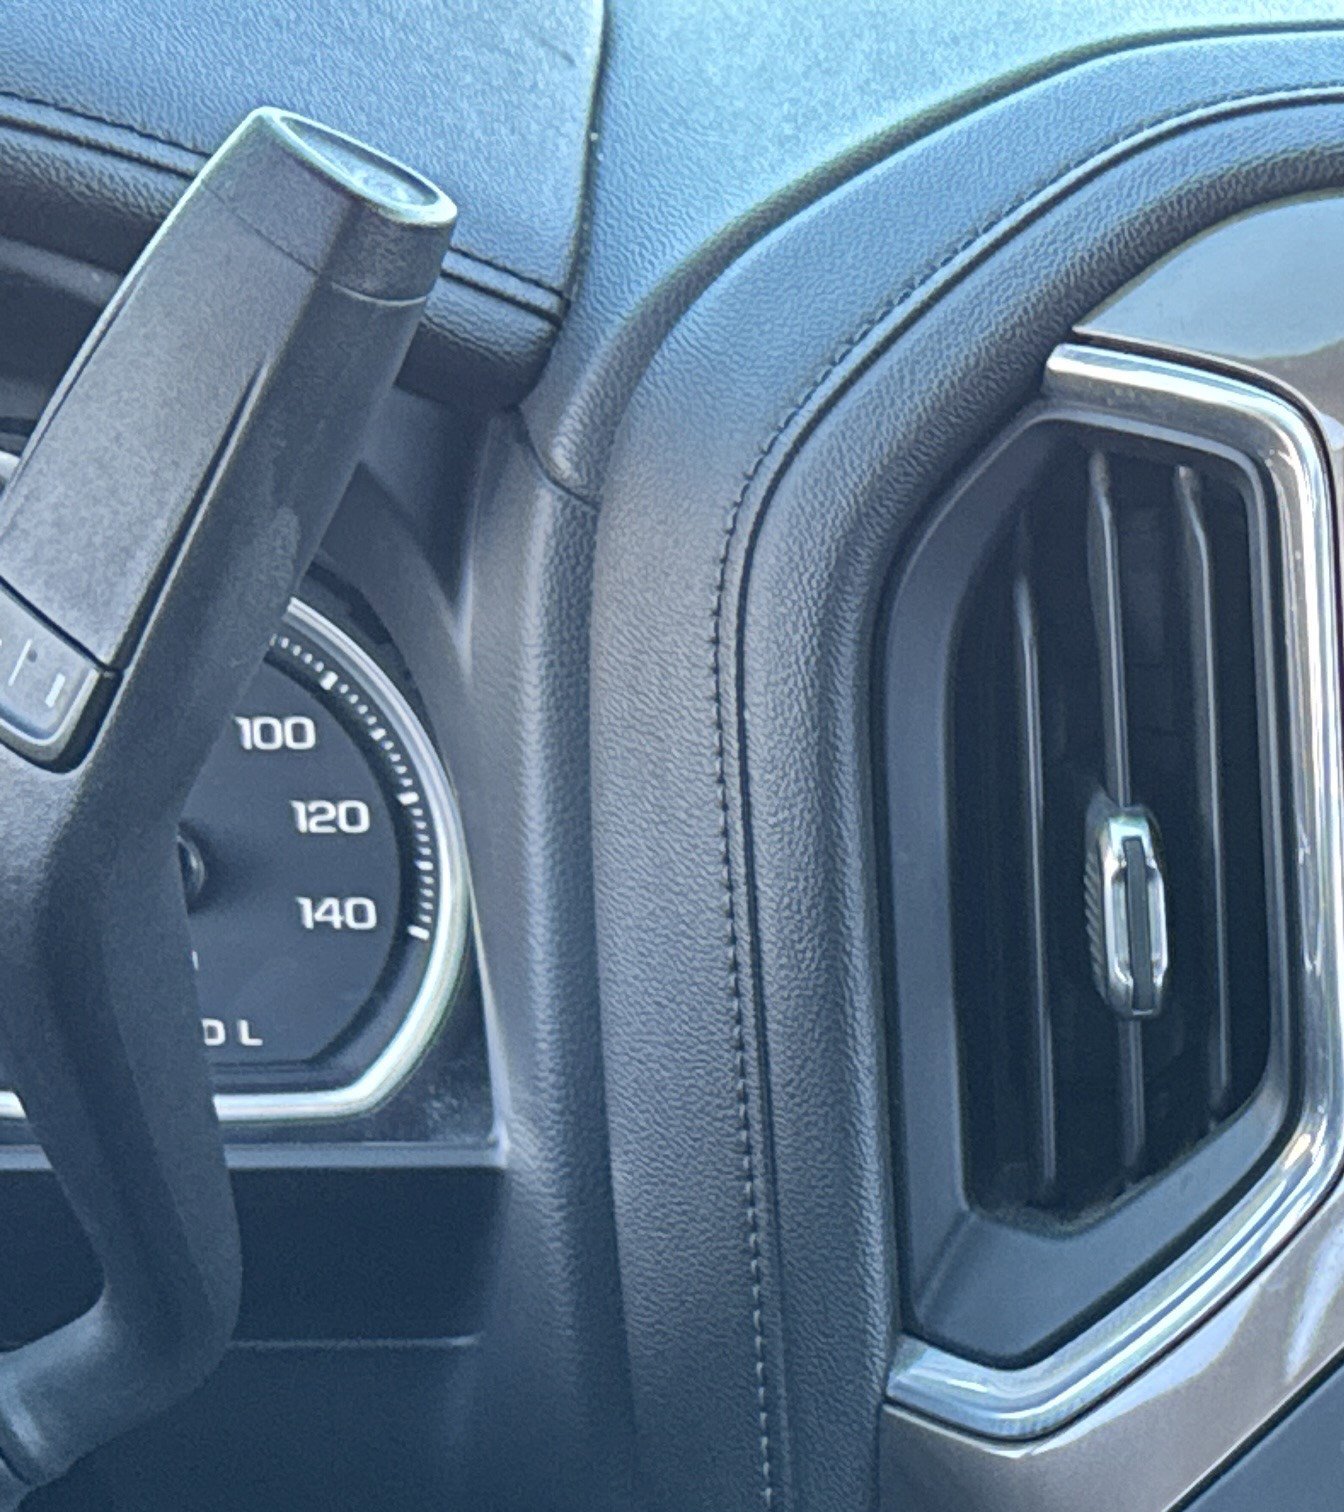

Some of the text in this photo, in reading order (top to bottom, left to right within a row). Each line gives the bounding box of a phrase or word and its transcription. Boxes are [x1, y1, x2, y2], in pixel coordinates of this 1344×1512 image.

[237, 716, 315, 749] 100
[292, 801, 369, 833] 120
[298, 898, 376, 930] 140
[201, 1018, 264, 1046] D L
